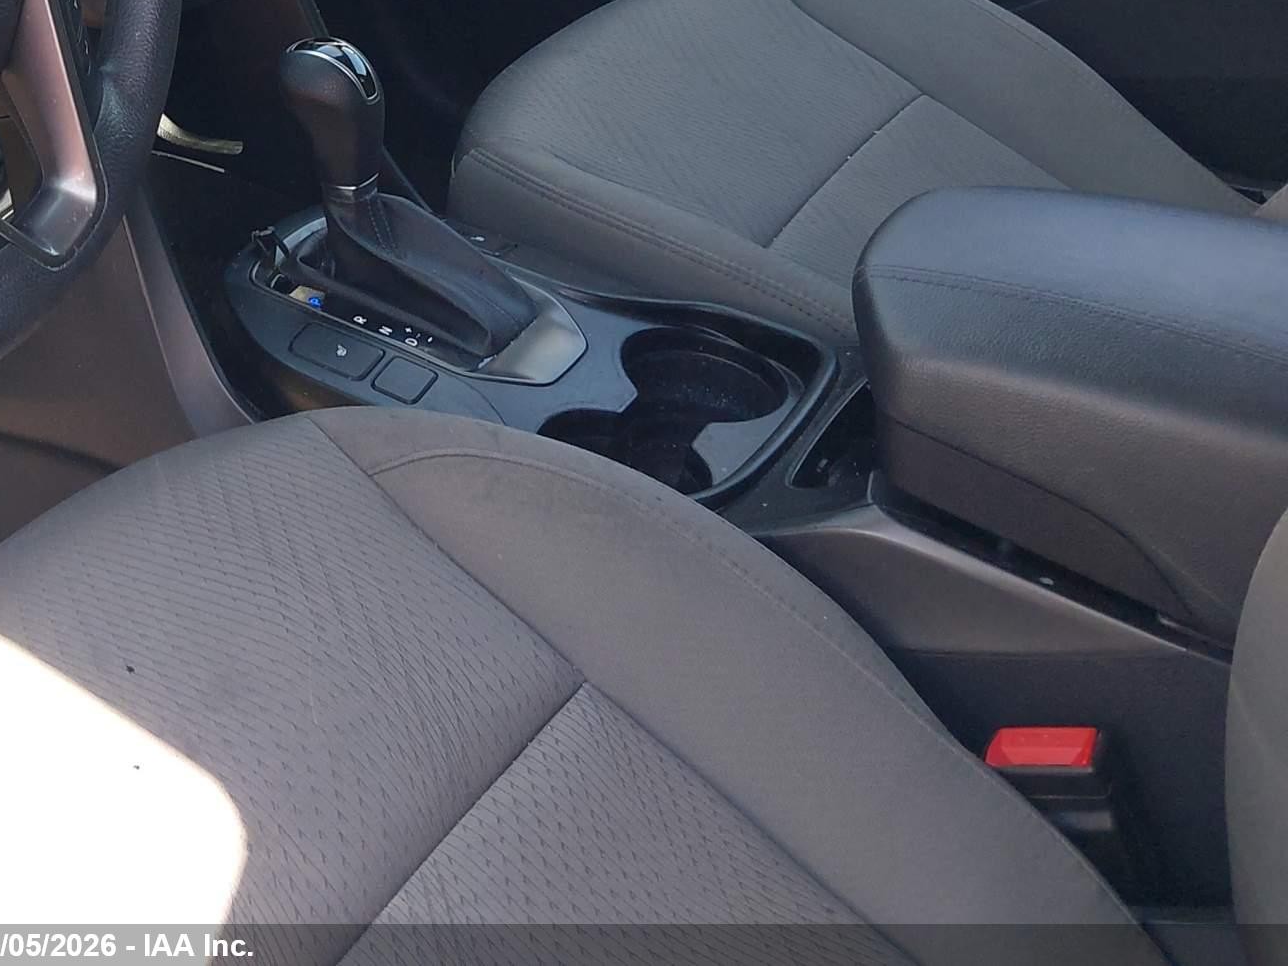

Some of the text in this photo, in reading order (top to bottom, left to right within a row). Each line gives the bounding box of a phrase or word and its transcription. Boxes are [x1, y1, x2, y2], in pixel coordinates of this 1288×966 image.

[353, 315, 367, 325] R
[379, 326, 393, 336] N
[405, 337, 418, 346] D
